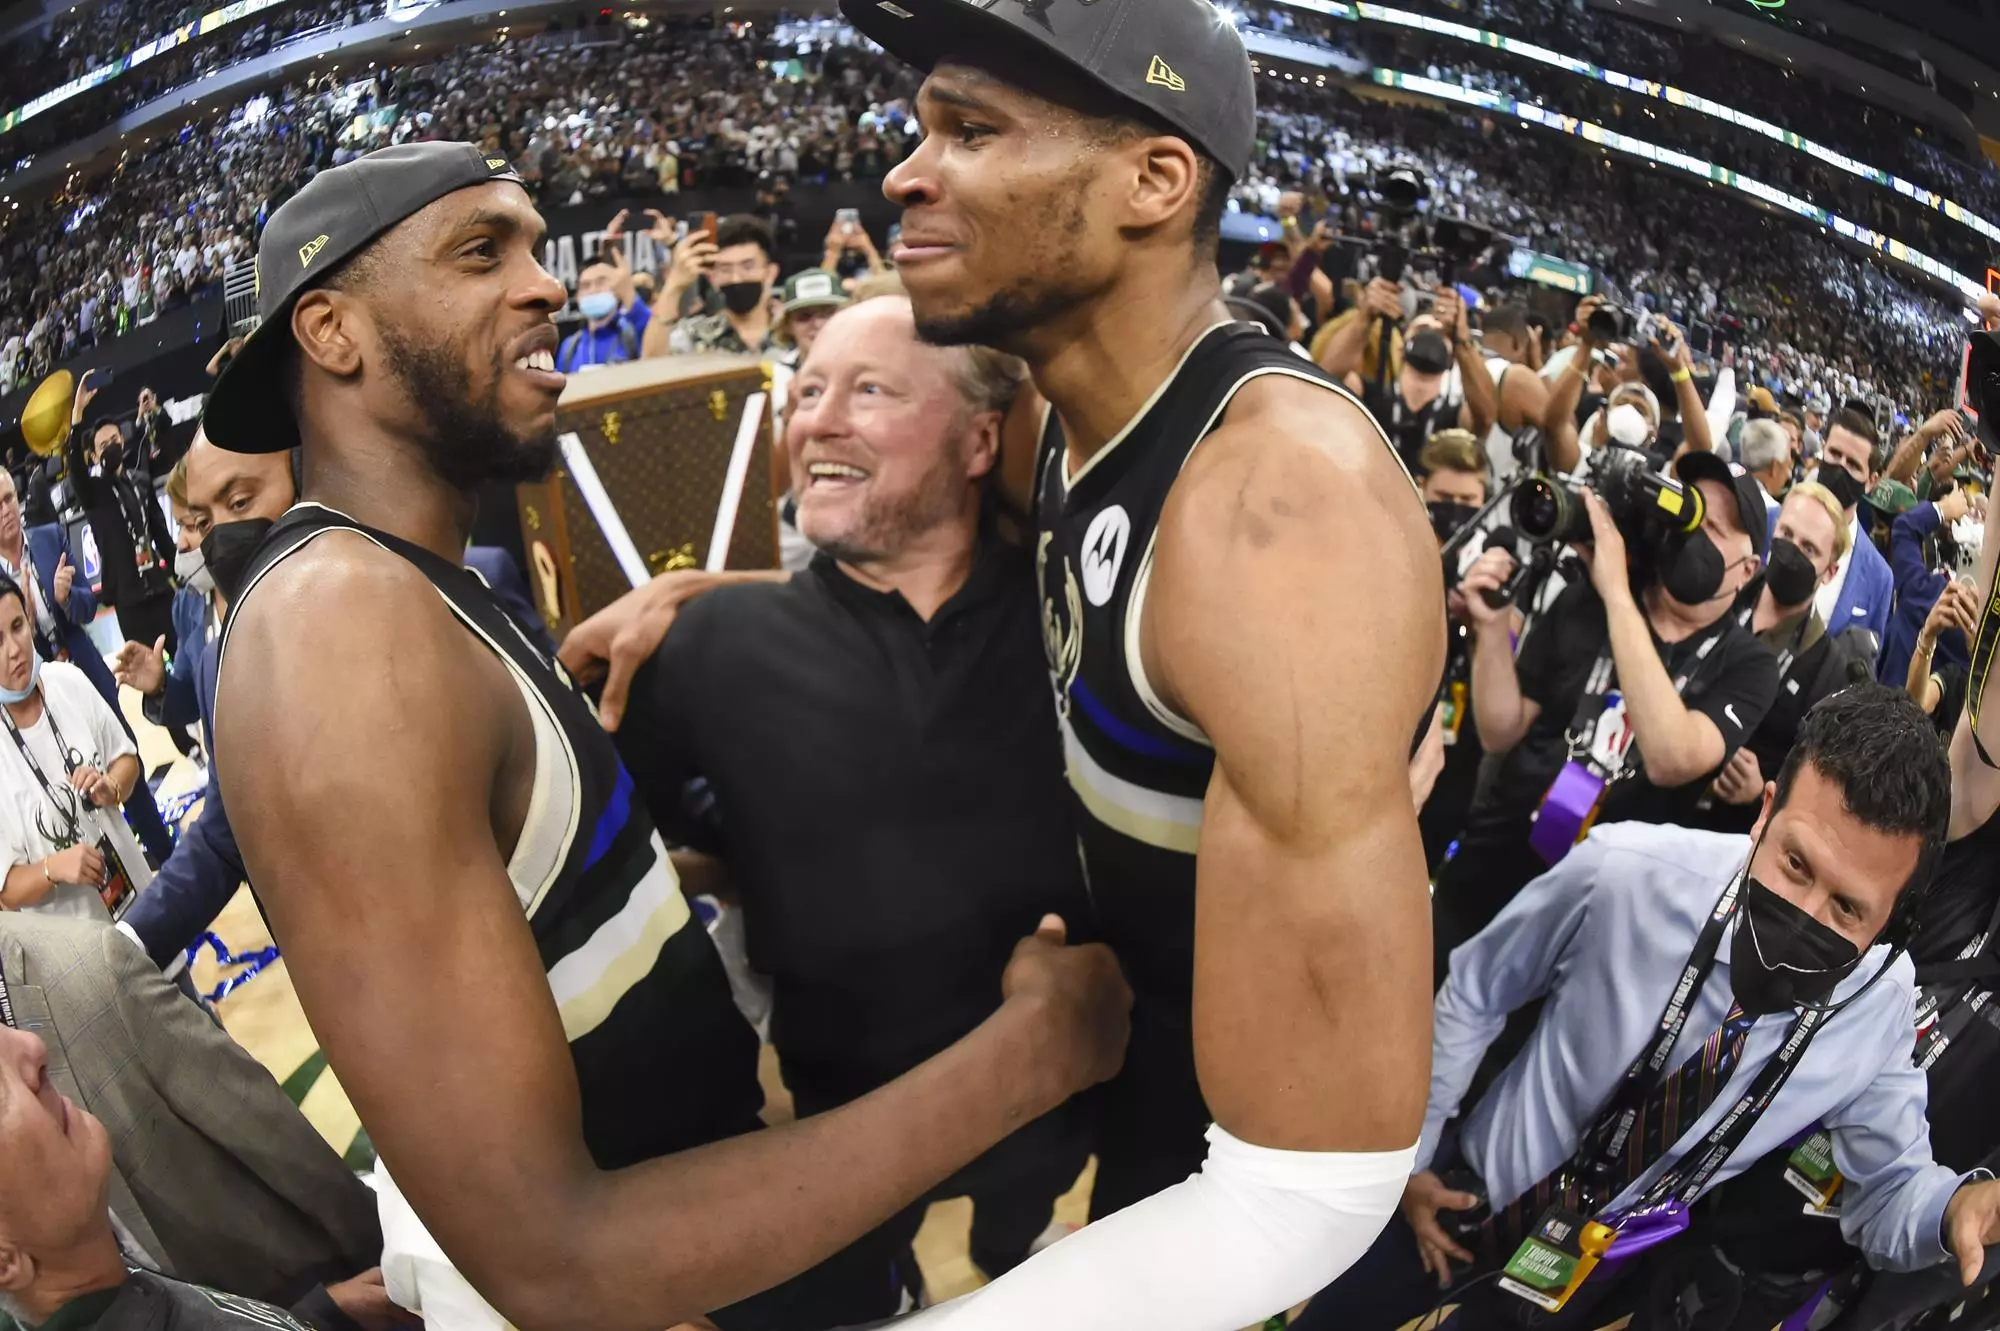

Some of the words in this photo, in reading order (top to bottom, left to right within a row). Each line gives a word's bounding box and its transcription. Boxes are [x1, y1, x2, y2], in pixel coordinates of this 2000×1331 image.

[1670, 975, 1694, 1007] FINALS
[1785, 1024, 1808, 1053] FINALS
[1523, 1244, 1561, 1267] TROPHY
